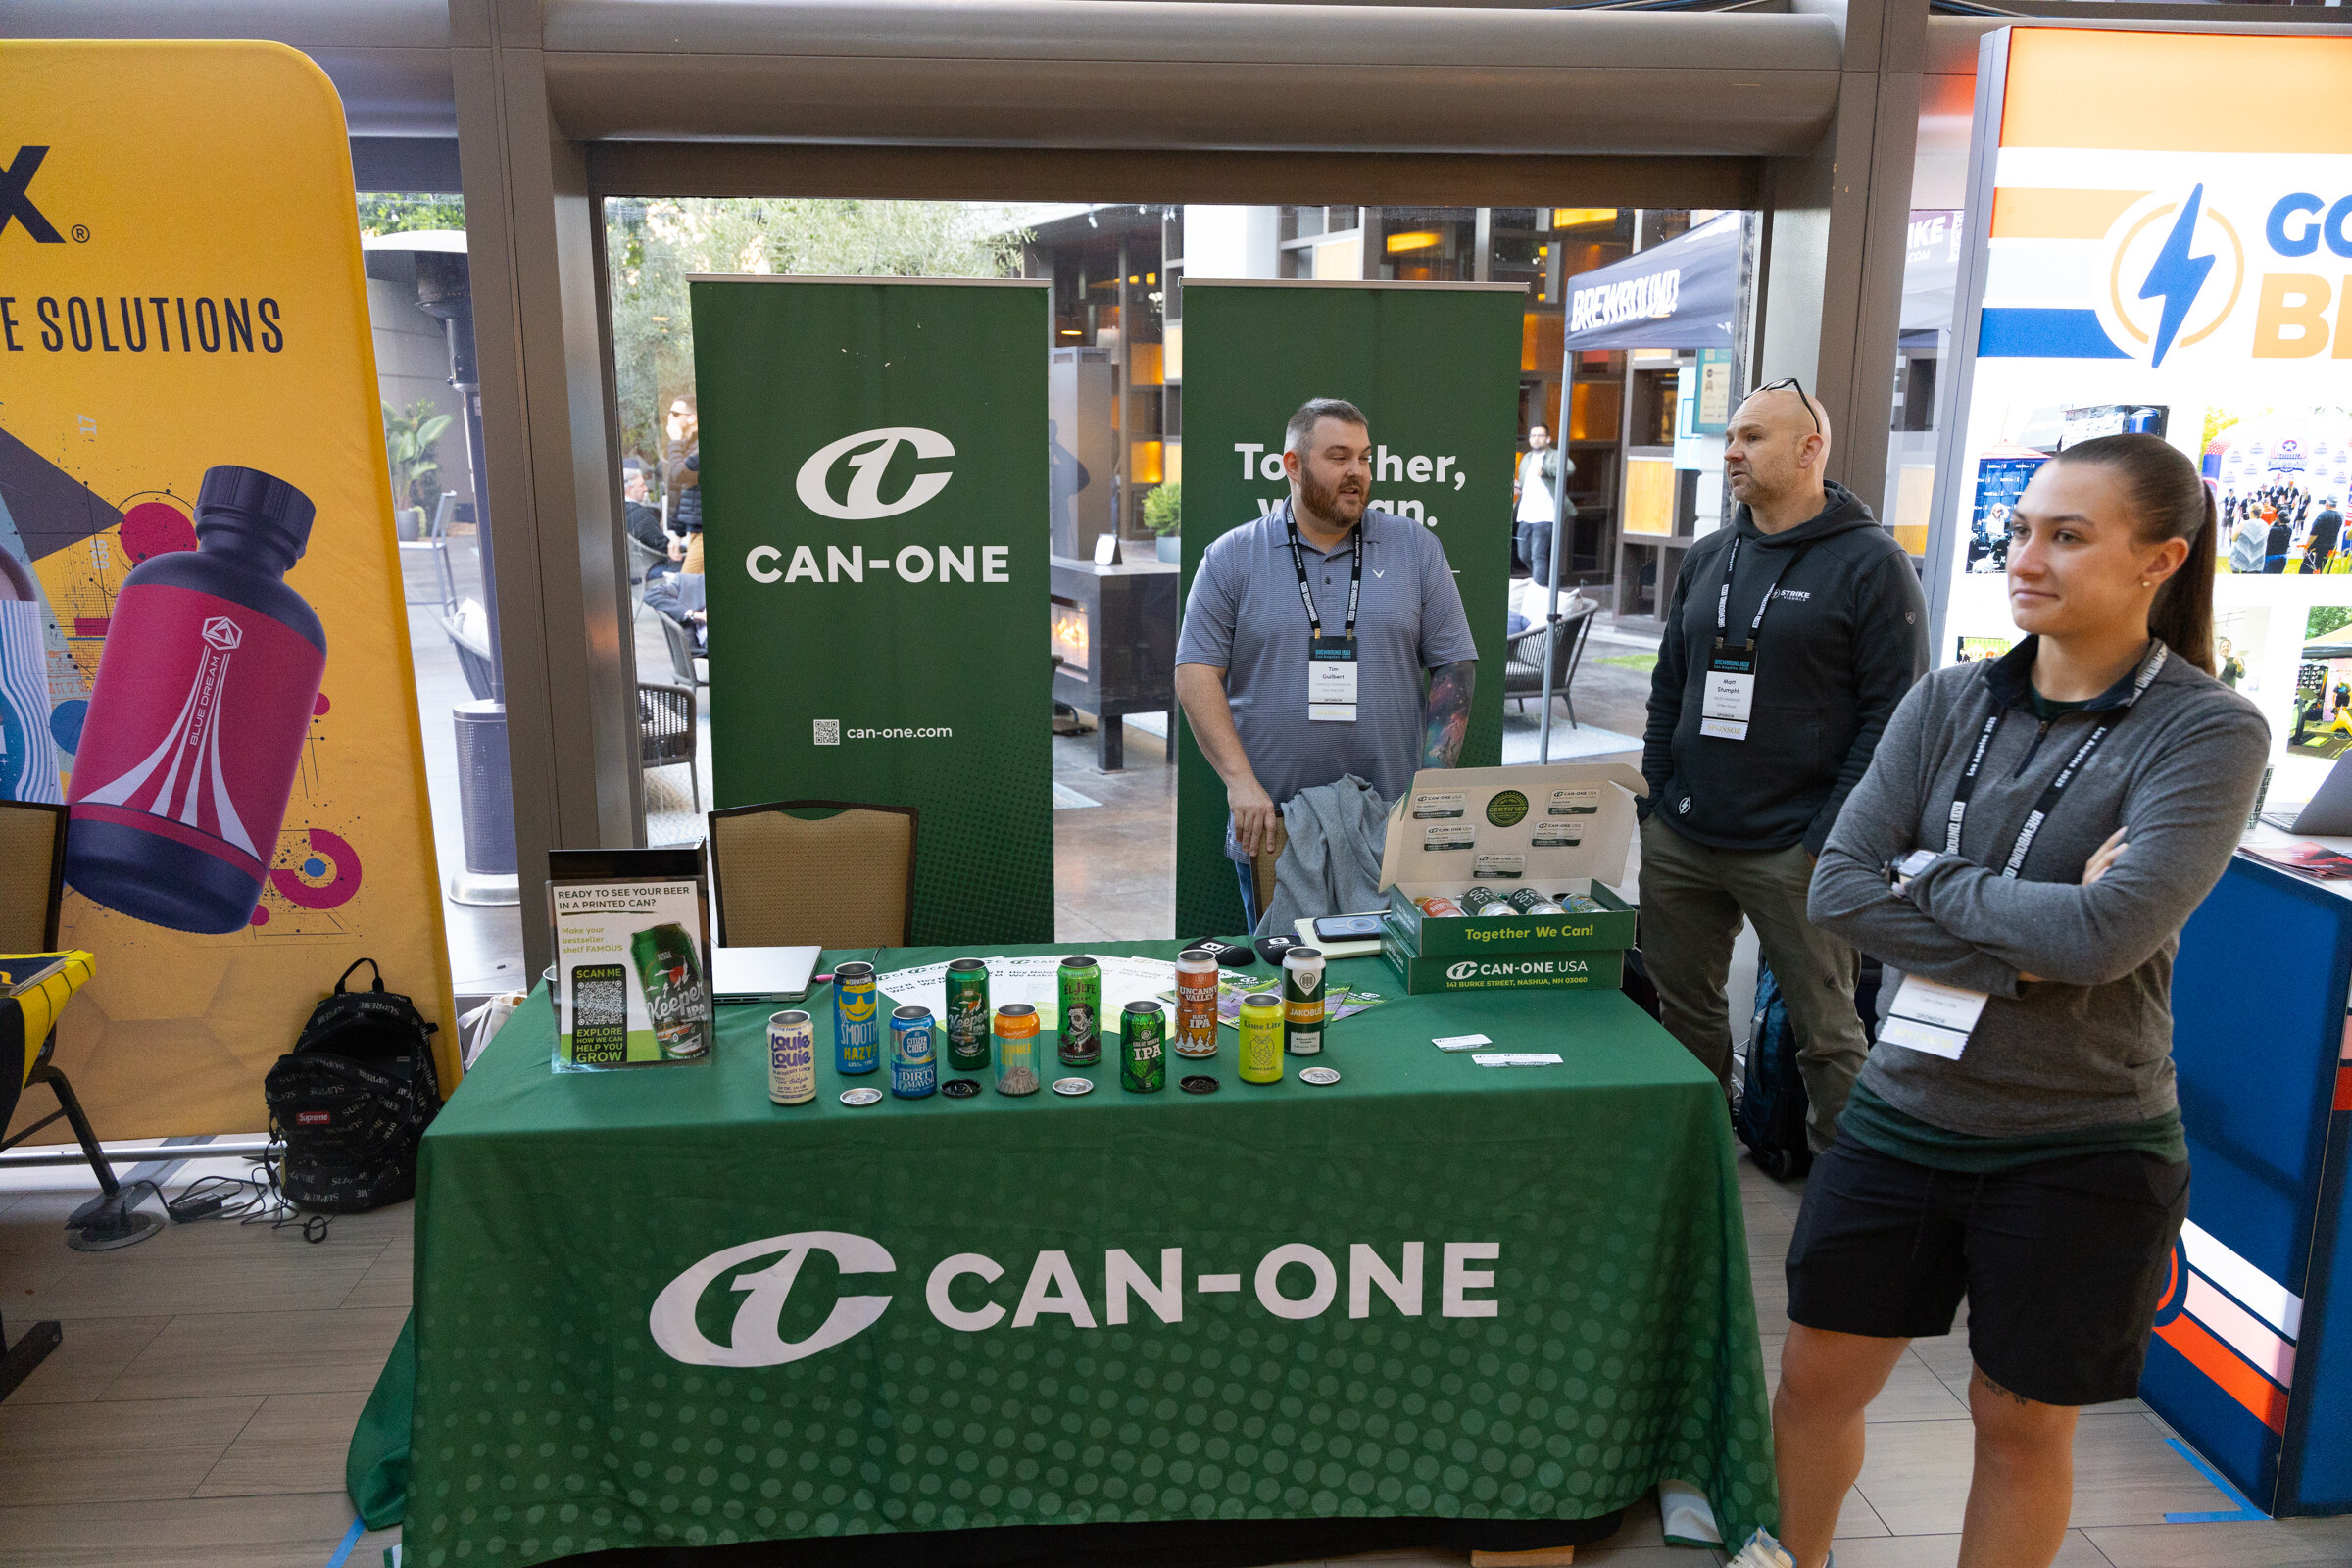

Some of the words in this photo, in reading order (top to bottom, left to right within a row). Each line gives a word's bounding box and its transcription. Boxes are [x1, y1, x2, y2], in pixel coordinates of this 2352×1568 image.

[37, 296, 284, 354] SOLUTIONS
[745, 544, 1010, 584] CAN-ONE
[189, 707, 206, 746] BLUE
[199, 656, 220, 706] DREAM
[846, 725, 953, 739] can-one.com
[1707, 724, 1741, 734] SPONSOR
[2091, 726, 2107, 740] Los
[1966, 763, 1978, 777] Los
[1972, 734, 1989, 763] Angeles
[2069, 739, 2096, 768] Angeles
[2054, 768, 2073, 788] 2025
[1949, 801, 1966, 822] LIVE
[1945, 821, 1961, 854] BOUND
[2008, 809, 2045, 869] BREWBOUND
[558, 889, 593, 899] READY
[612, 888, 629, 897] SEE
[632, 887, 662, 896] YOUR
[663, 886, 690, 895] BEER
[582, 900, 626, 908] PRINTED
[1465, 927, 1530, 942] Together
[1536, 926, 1557, 938] We
[1561, 924, 1593, 937] Can!
[585, 944, 623, 953] FAMOUS
[576, 969, 605, 979] SCAN
[607, 968, 621, 977] ME
[1480, 961, 1553, 975] CAN-ONE
[1558, 960, 1588, 973] USA
[1074, 982, 1096, 995] JEFE
[1180, 985, 1218, 995] UNCANNY
[1486, 979, 1515, 988] STREET,
[1517, 978, 1550, 987] NASHUA,
[359, 1001, 401, 1016] SUPREME
[648, 981, 705, 1024] Keeper
[687, 1004, 705, 1017] IPA
[1290, 1006, 1322, 1016] JAKOBUS
[948, 1009, 988, 1032] Keeper
[1189, 1018, 1211, 1028] IPA
[1244, 1020, 1263, 1029] Lime
[576, 1027, 623, 1037] EXPLORE
[841, 1021, 878, 1046] SMOOTH
[771, 1031, 810, 1052] Louie
[907, 1036, 927, 1045] CITIZEN
[844, 1045, 871, 1060] HAZY
[907, 1042, 927, 1054] CIDER
[1002, 1043, 1031, 1054] SUMMER
[1134, 1043, 1162, 1061] IPA
[576, 1051, 622, 1063] GROW
[772, 1050, 810, 1068] Louie
[357, 1068, 390, 1087] SUPREME
[902, 1067, 934, 1081] DIRTY
[907, 1077, 934, 1088] MAYOR
[299, 1113, 328, 1122] Supreme
[925, 1241, 1500, 1332] CAN-ONE
